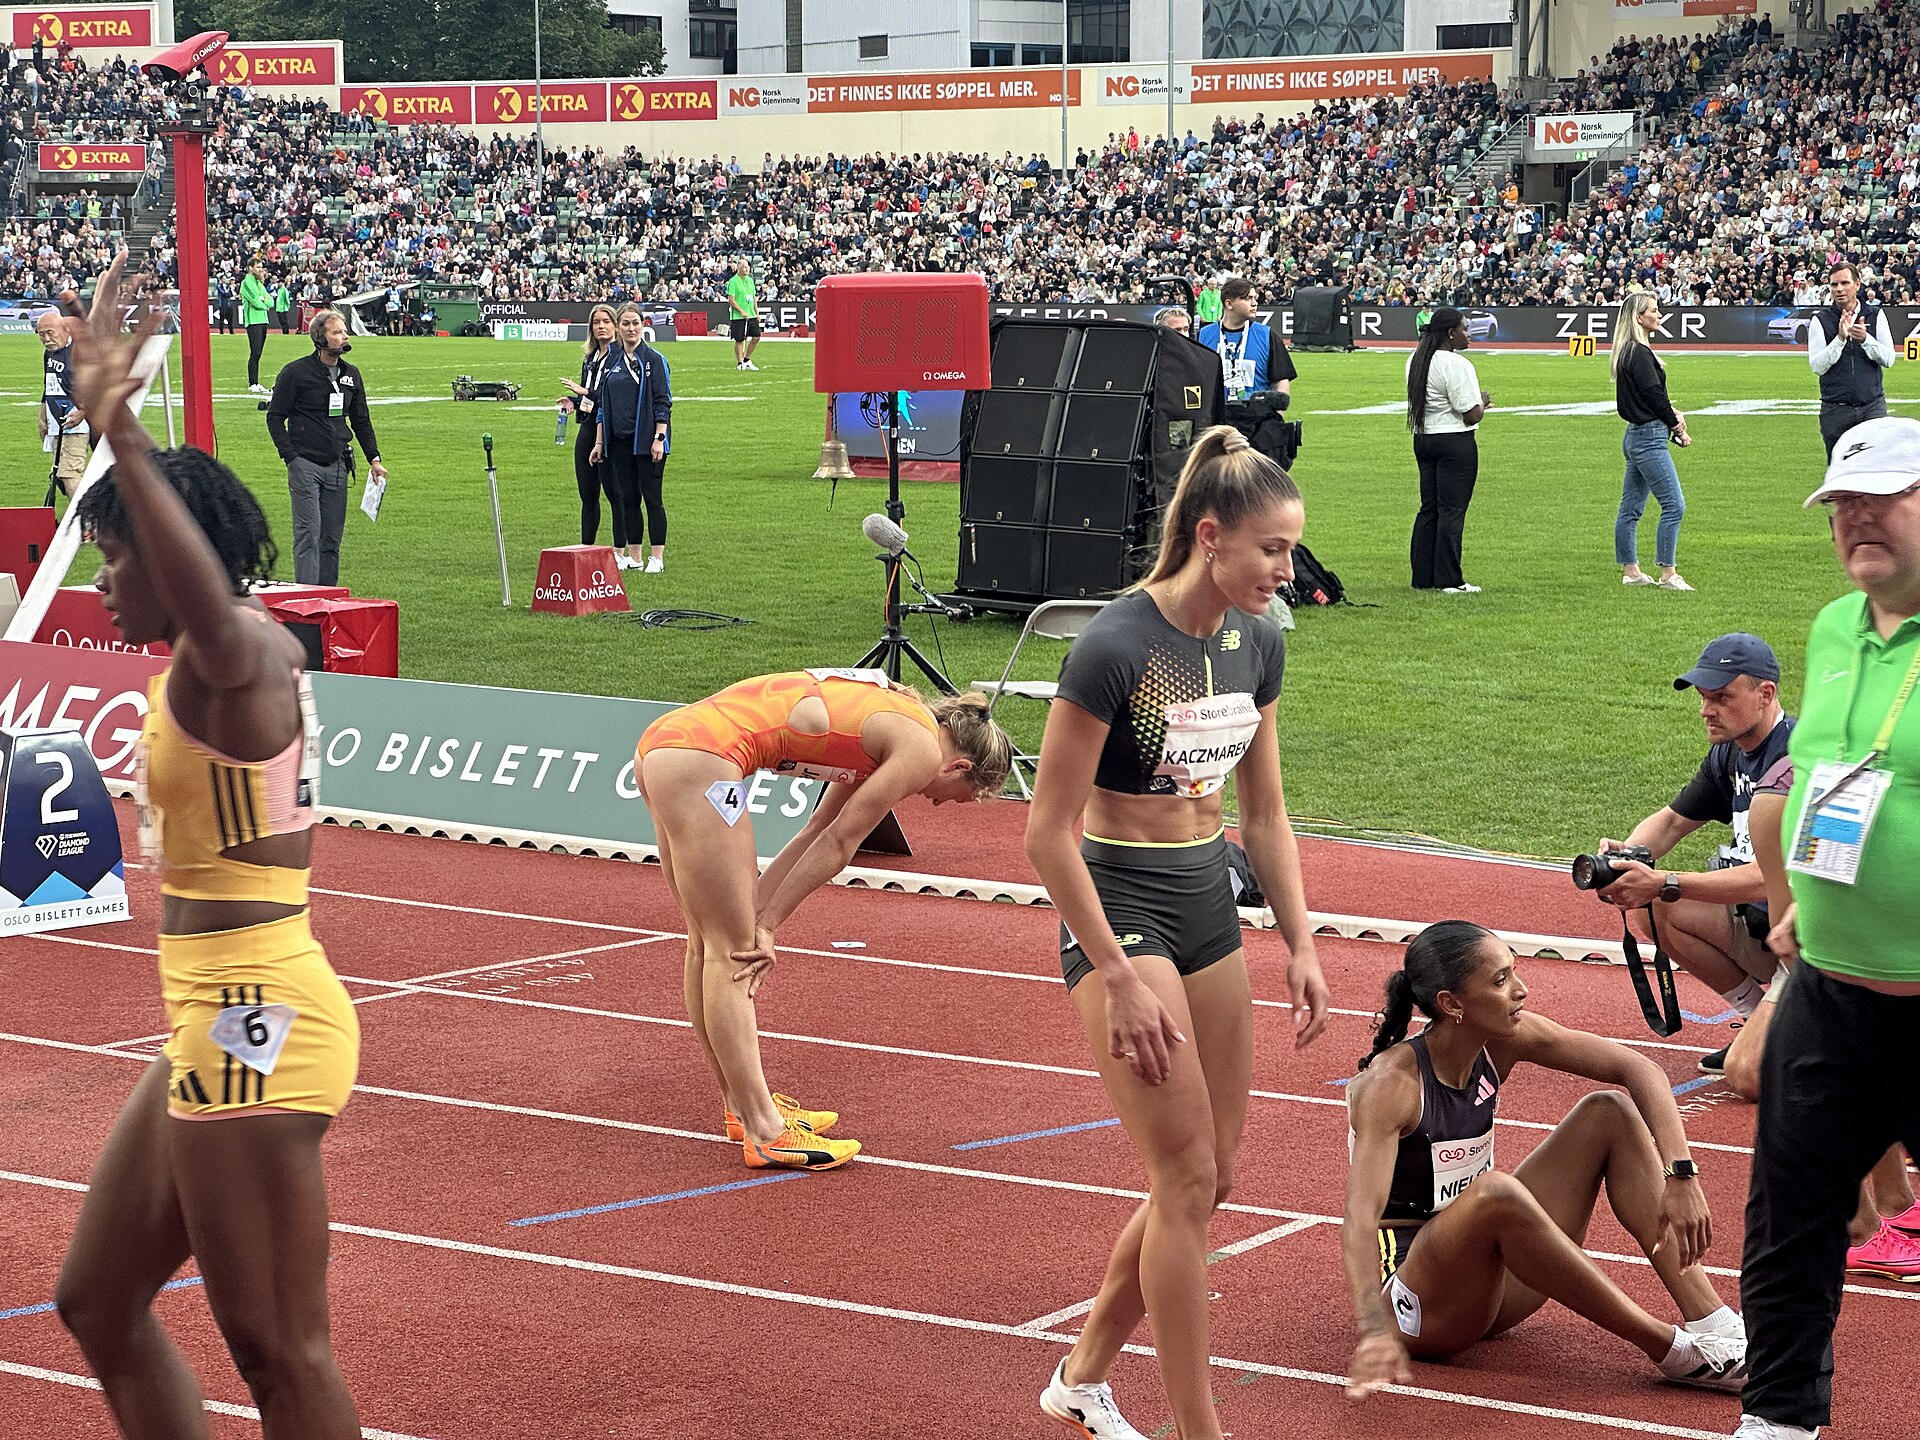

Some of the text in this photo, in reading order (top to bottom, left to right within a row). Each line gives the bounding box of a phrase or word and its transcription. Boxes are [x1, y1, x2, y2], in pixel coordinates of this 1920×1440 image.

[69, 20, 132, 37] EXTRA
[200, 39, 222, 58] OMEGA
[254, 58, 317, 75] EXTRA
[1106, 75, 1140, 97] NG
[1190, 74, 1222, 92] DET
[1226, 73, 1285, 90] FINNES
[1289, 71, 1328, 89] IKKE
[1332, 69, 1397, 88] SØPPEL
[729, 87, 761, 108] NG
[762, 89, 782, 97] Norsk
[808, 80, 1038, 102] DET FINNES IKKE SØPPEL MER.
[1142, 86, 1183, 95] Gjenvinng
[393, 96, 454, 114] EXTRA
[527, 94, 589, 112] EXTRA
[650, 91, 713, 110] EXTRA
[762, 95, 800, 106] Gjenvinning
[1544, 120, 1579, 144] NG
[1581, 122, 1602, 131] Norsk
[1581, 131, 1623, 142] Gjenvinning
[81, 152, 131, 164] EXTRA
[483, 304, 527, 315] OFFICIAL
[526, 326, 567, 339] Instab
[1256, 311, 1383, 336] ZER
[1555, 312, 1706, 339] ZEKR
[1572, 337, 1594, 356] 70
[1908, 340, 1920, 360] 6
[933, 371, 966, 380] OMEGA
[535, 587, 574, 602] OMEGA
[579, 583, 625, 601] OMEGA
[1164, 739, 1250, 765] KACZMAREK
[376, 732, 600, 794] BISLETT
[615, 762, 814, 818] GES
[35, 751, 79, 825] 2
[725, 787, 739, 809] 4
[58, 836, 90, 849] DIAMOND
[58, 845, 84, 857] LEAGUE
[4, 902, 125, 927] OSLO BISLETT GAMES
[243, 1010, 268, 1047] 6
